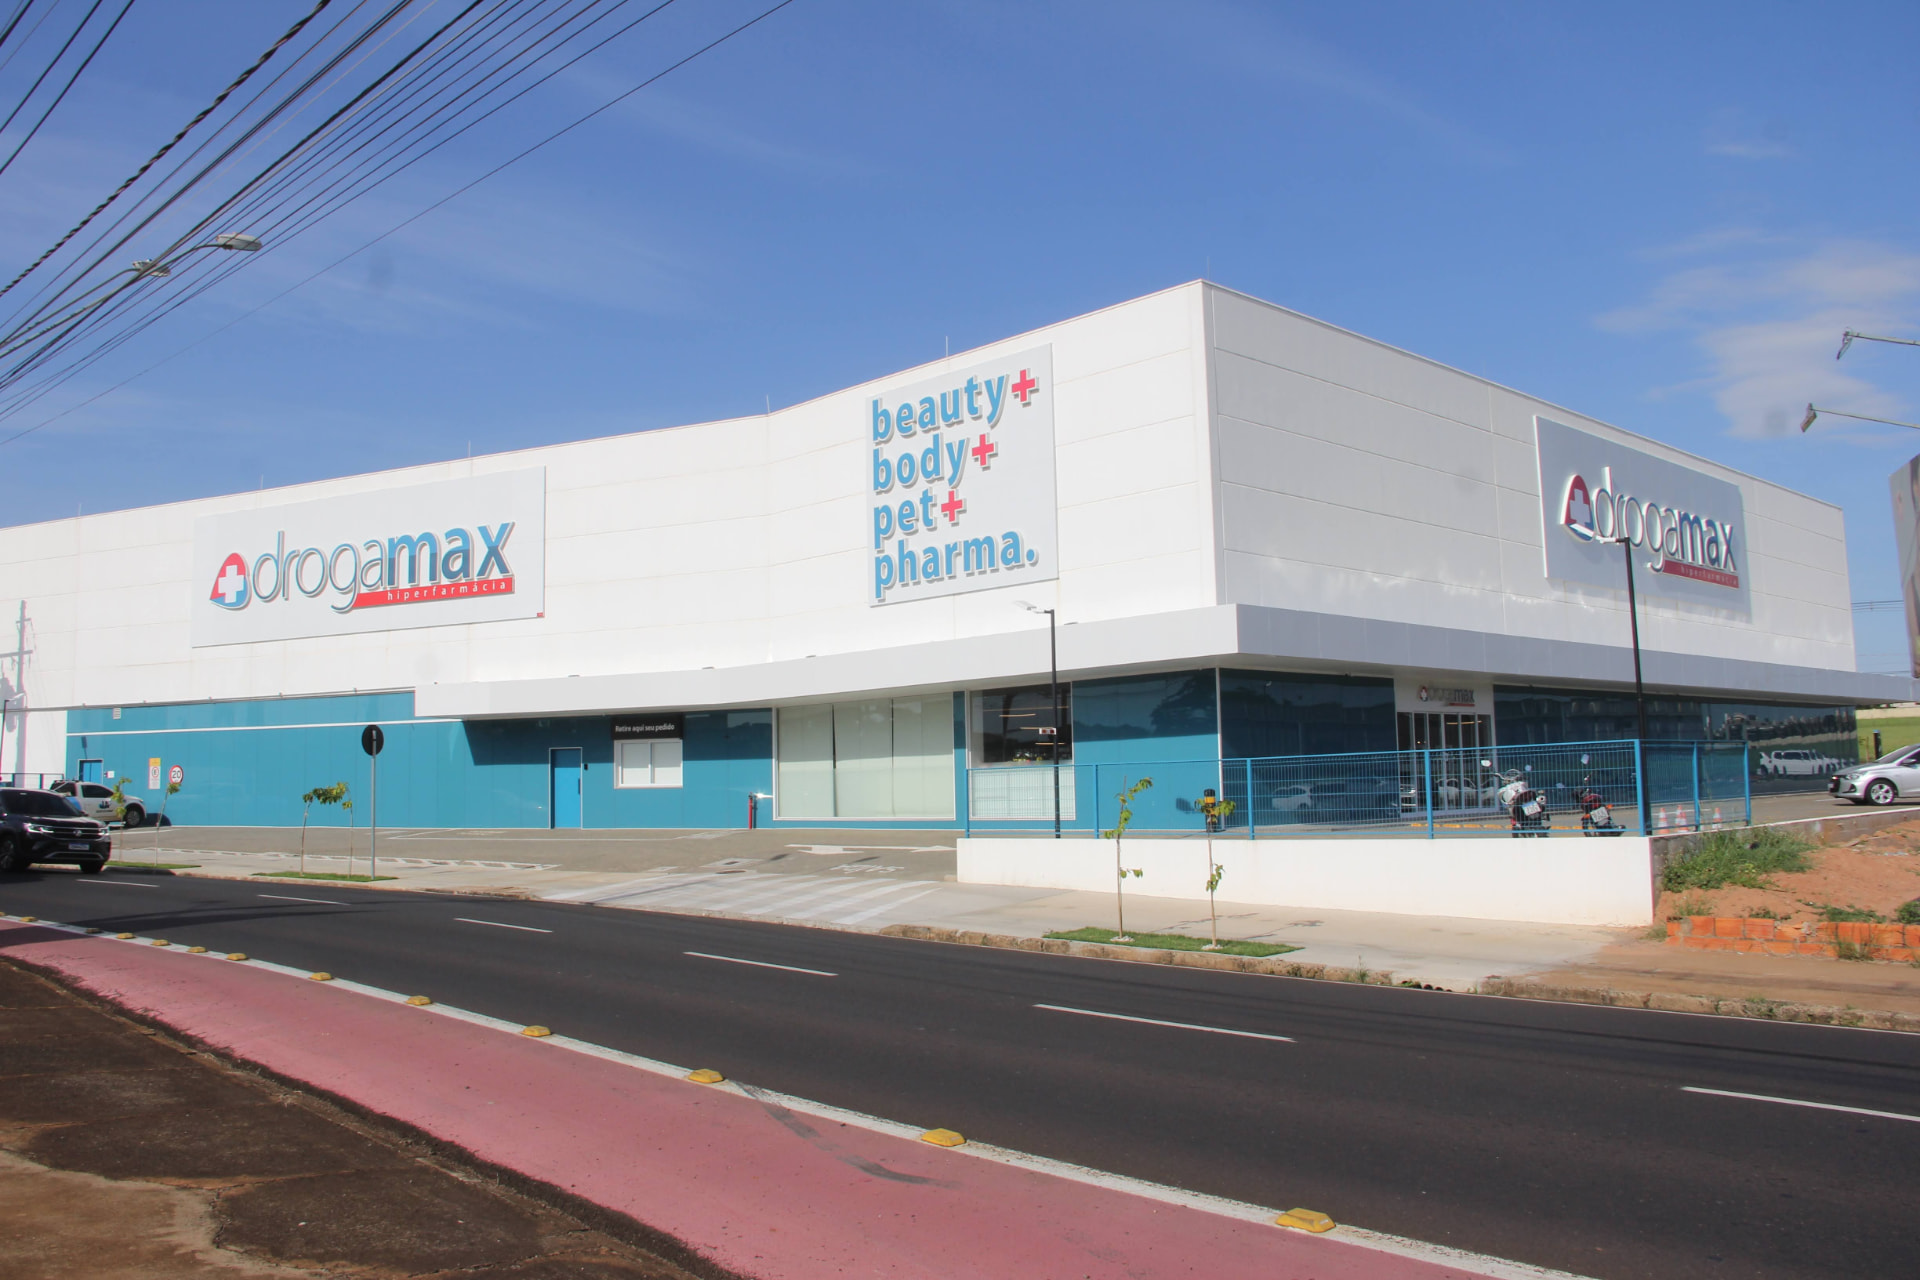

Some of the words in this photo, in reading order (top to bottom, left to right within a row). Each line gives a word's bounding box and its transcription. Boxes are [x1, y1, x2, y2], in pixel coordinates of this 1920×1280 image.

[1593, 466, 1736, 572] drogamax
[252, 522, 514, 613] drogamax
[387, 581, 507, 600] hiperfarmácia
[172, 770, 181, 779] 20
